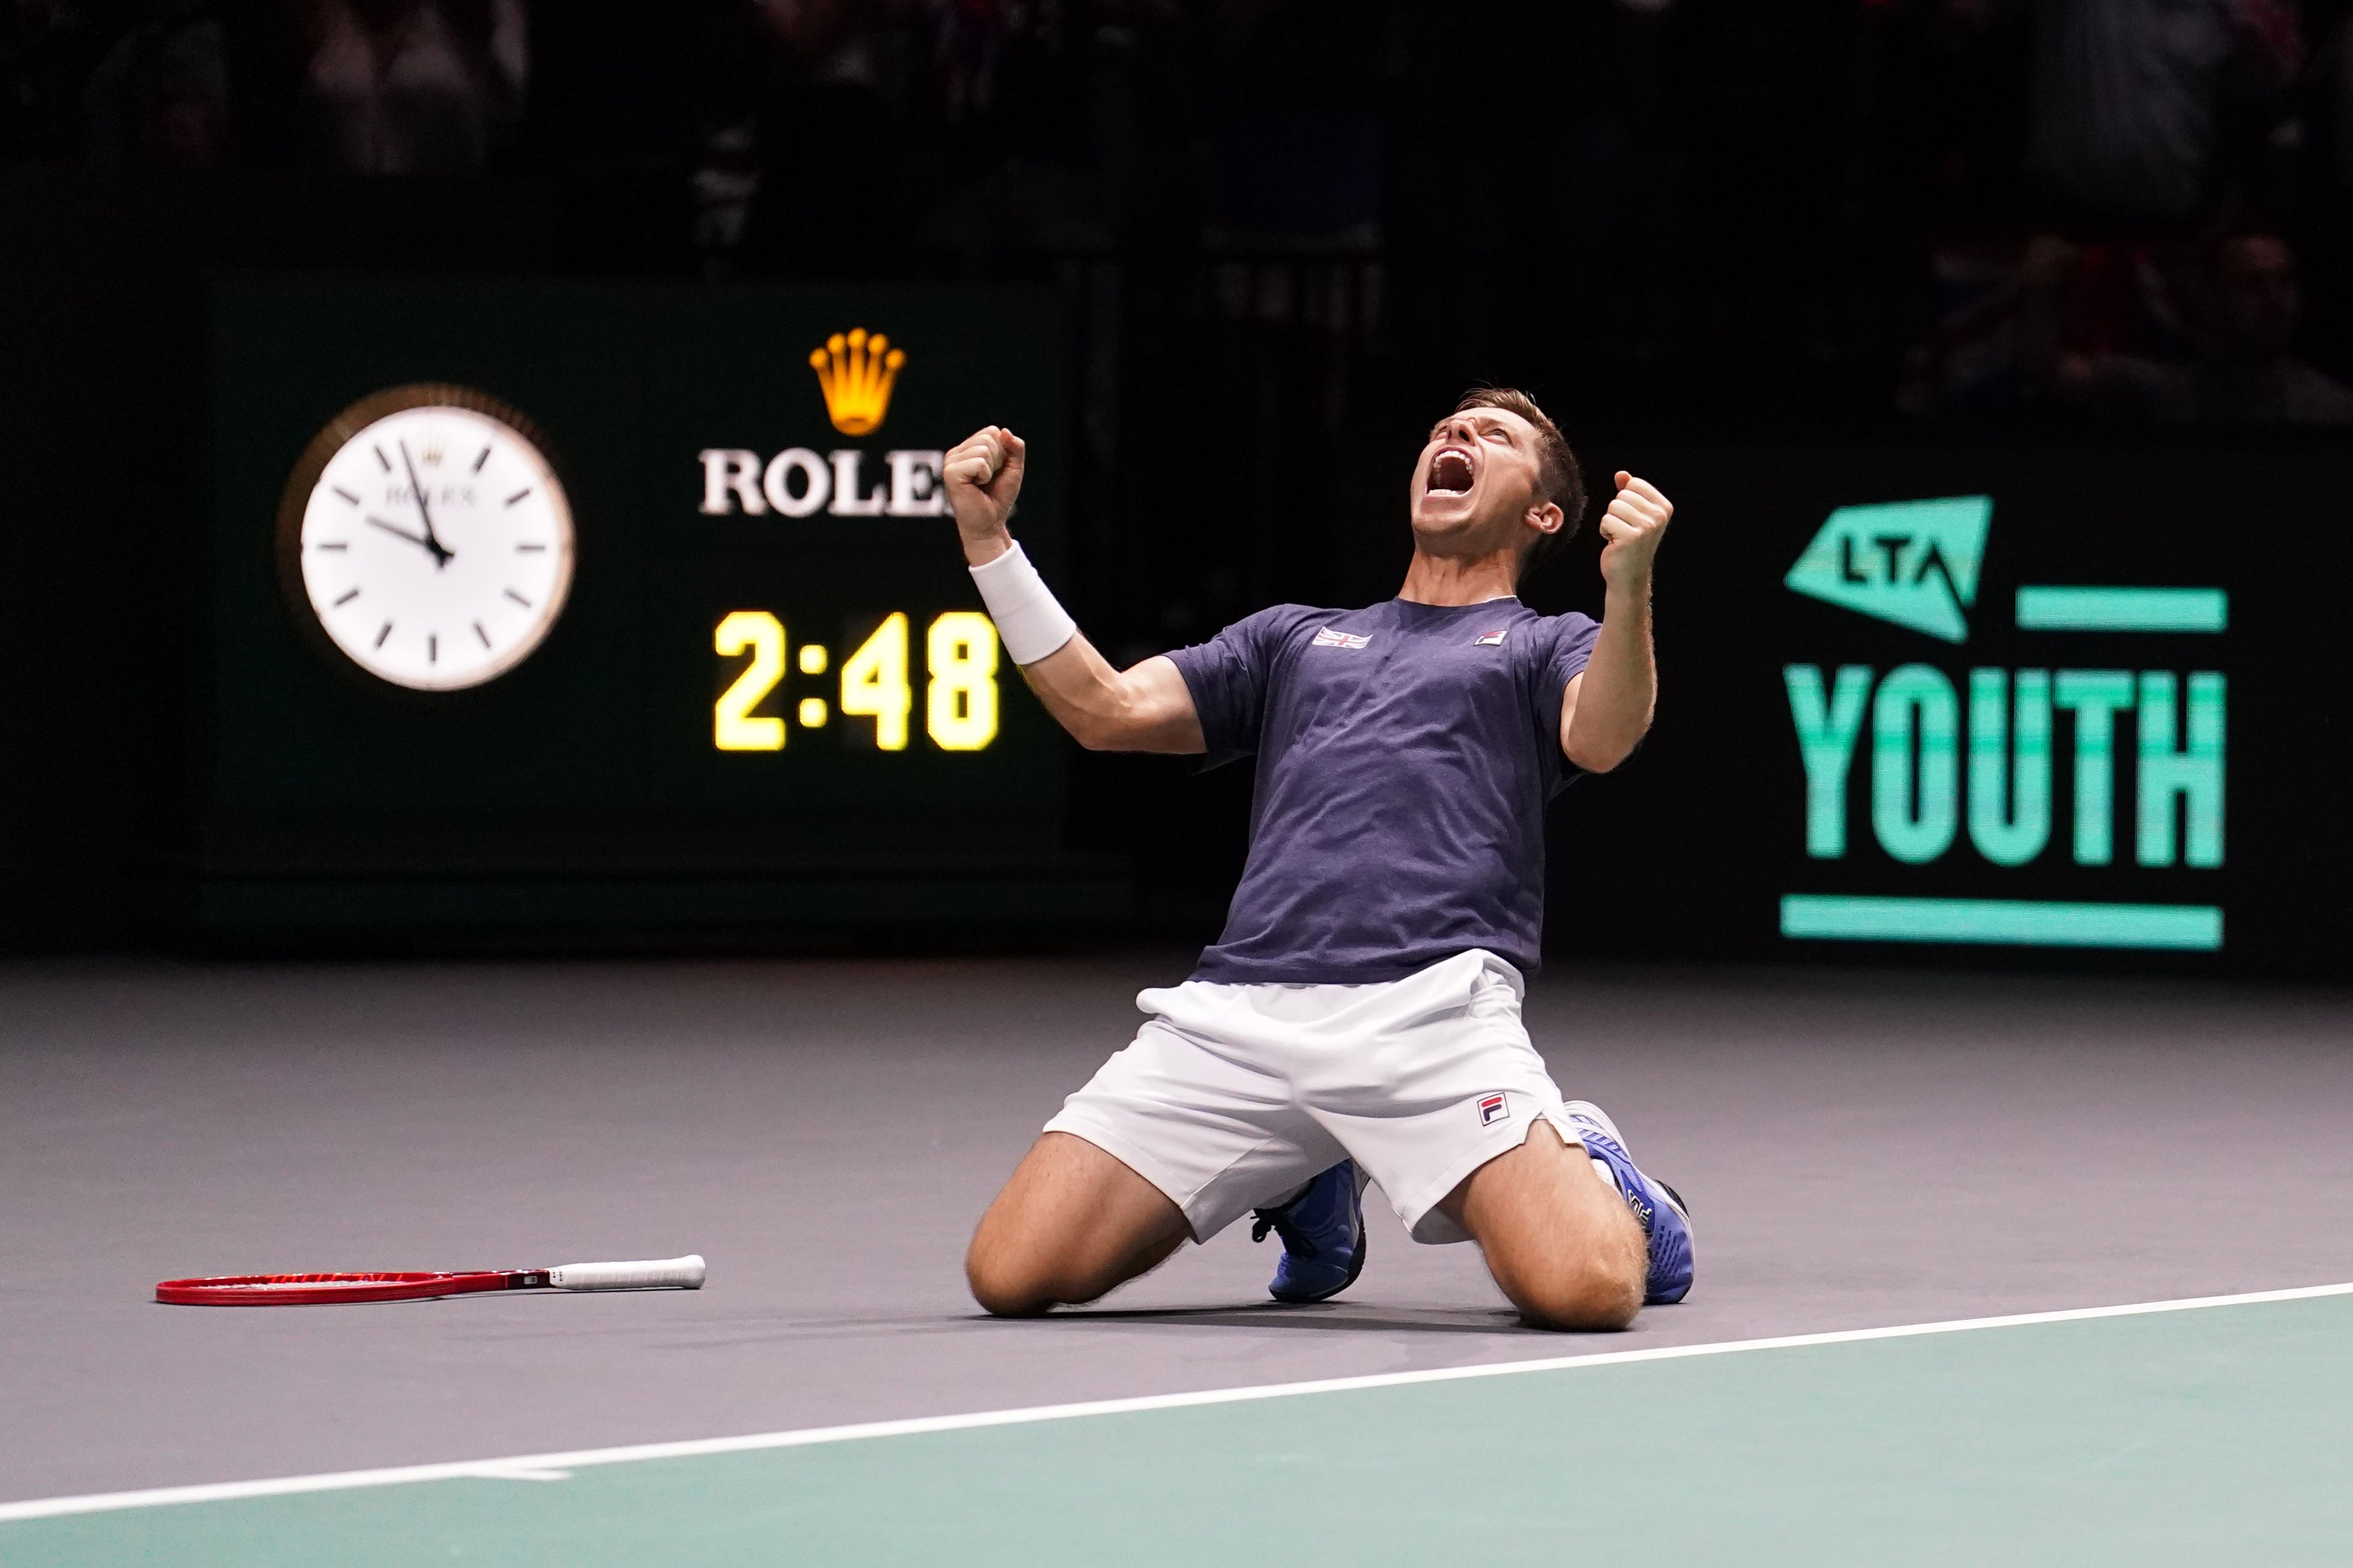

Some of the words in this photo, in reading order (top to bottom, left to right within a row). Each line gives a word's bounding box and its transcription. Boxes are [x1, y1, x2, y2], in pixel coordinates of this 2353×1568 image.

[698, 448, 1016, 517] ROLE
[1839, 530, 1960, 600] LTA
[713, 610, 1001, 752] 2:48
[1782, 662, 2226, 868] YOUTH
